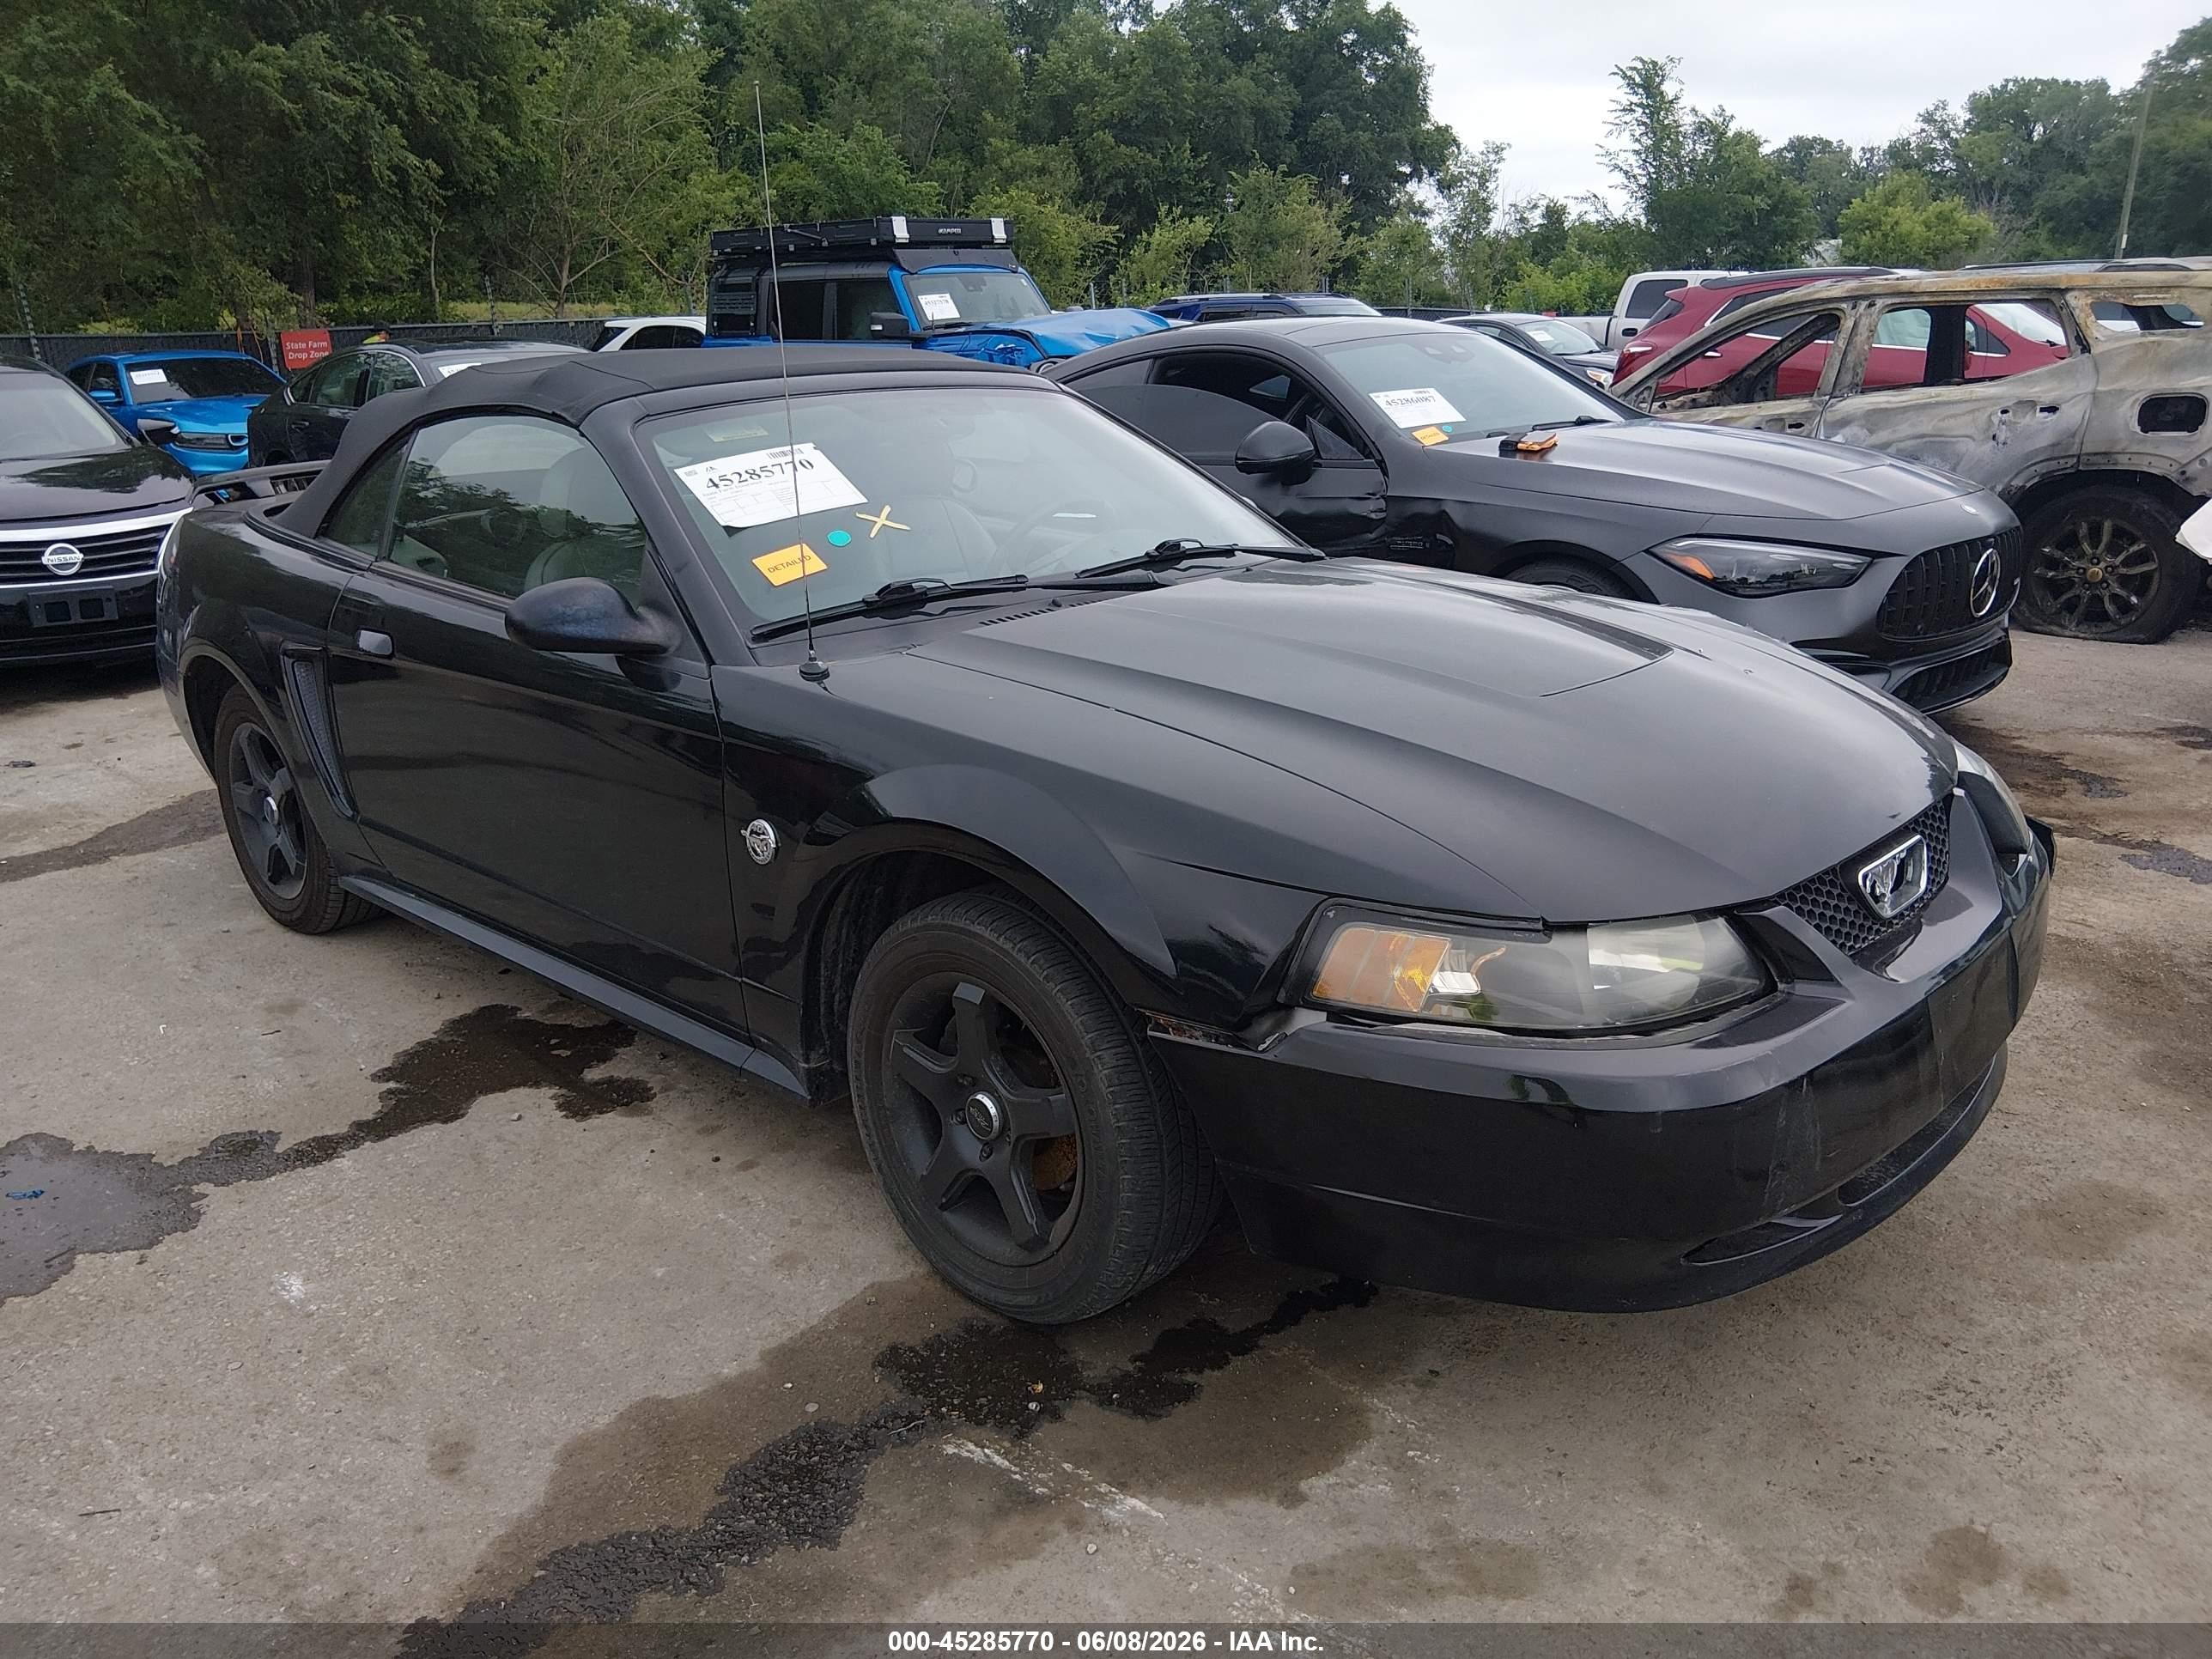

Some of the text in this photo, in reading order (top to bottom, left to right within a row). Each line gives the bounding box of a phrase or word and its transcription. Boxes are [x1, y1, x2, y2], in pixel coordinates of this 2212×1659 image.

[289, 351, 308, 361] Drop
[706, 458, 815, 490] 45285770
[46, 555, 82, 563] NISSAN
[767, 555, 811, 574] DETAILED
